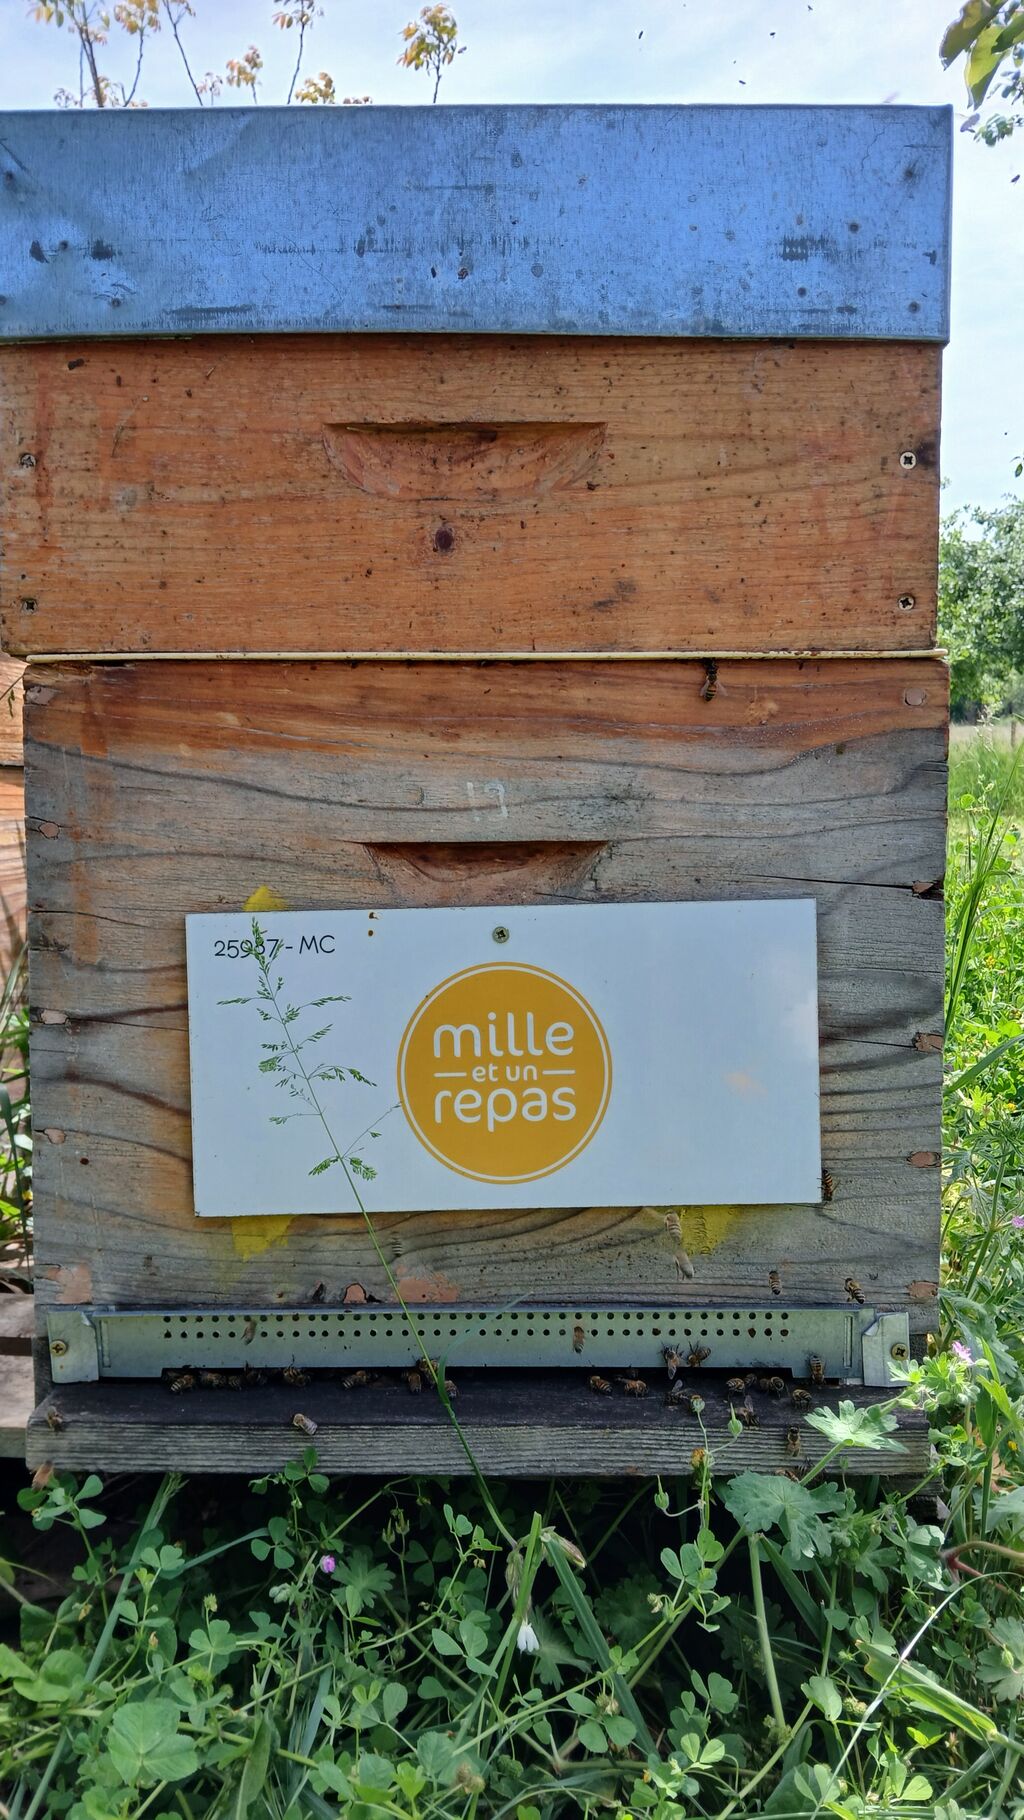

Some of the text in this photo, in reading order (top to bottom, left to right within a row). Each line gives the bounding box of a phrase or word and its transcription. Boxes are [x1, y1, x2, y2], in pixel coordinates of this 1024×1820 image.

[433, 1011, 575, 1058] mille
[471, 1063, 538, 1082] et un
[434, 1086, 577, 1132] repas
